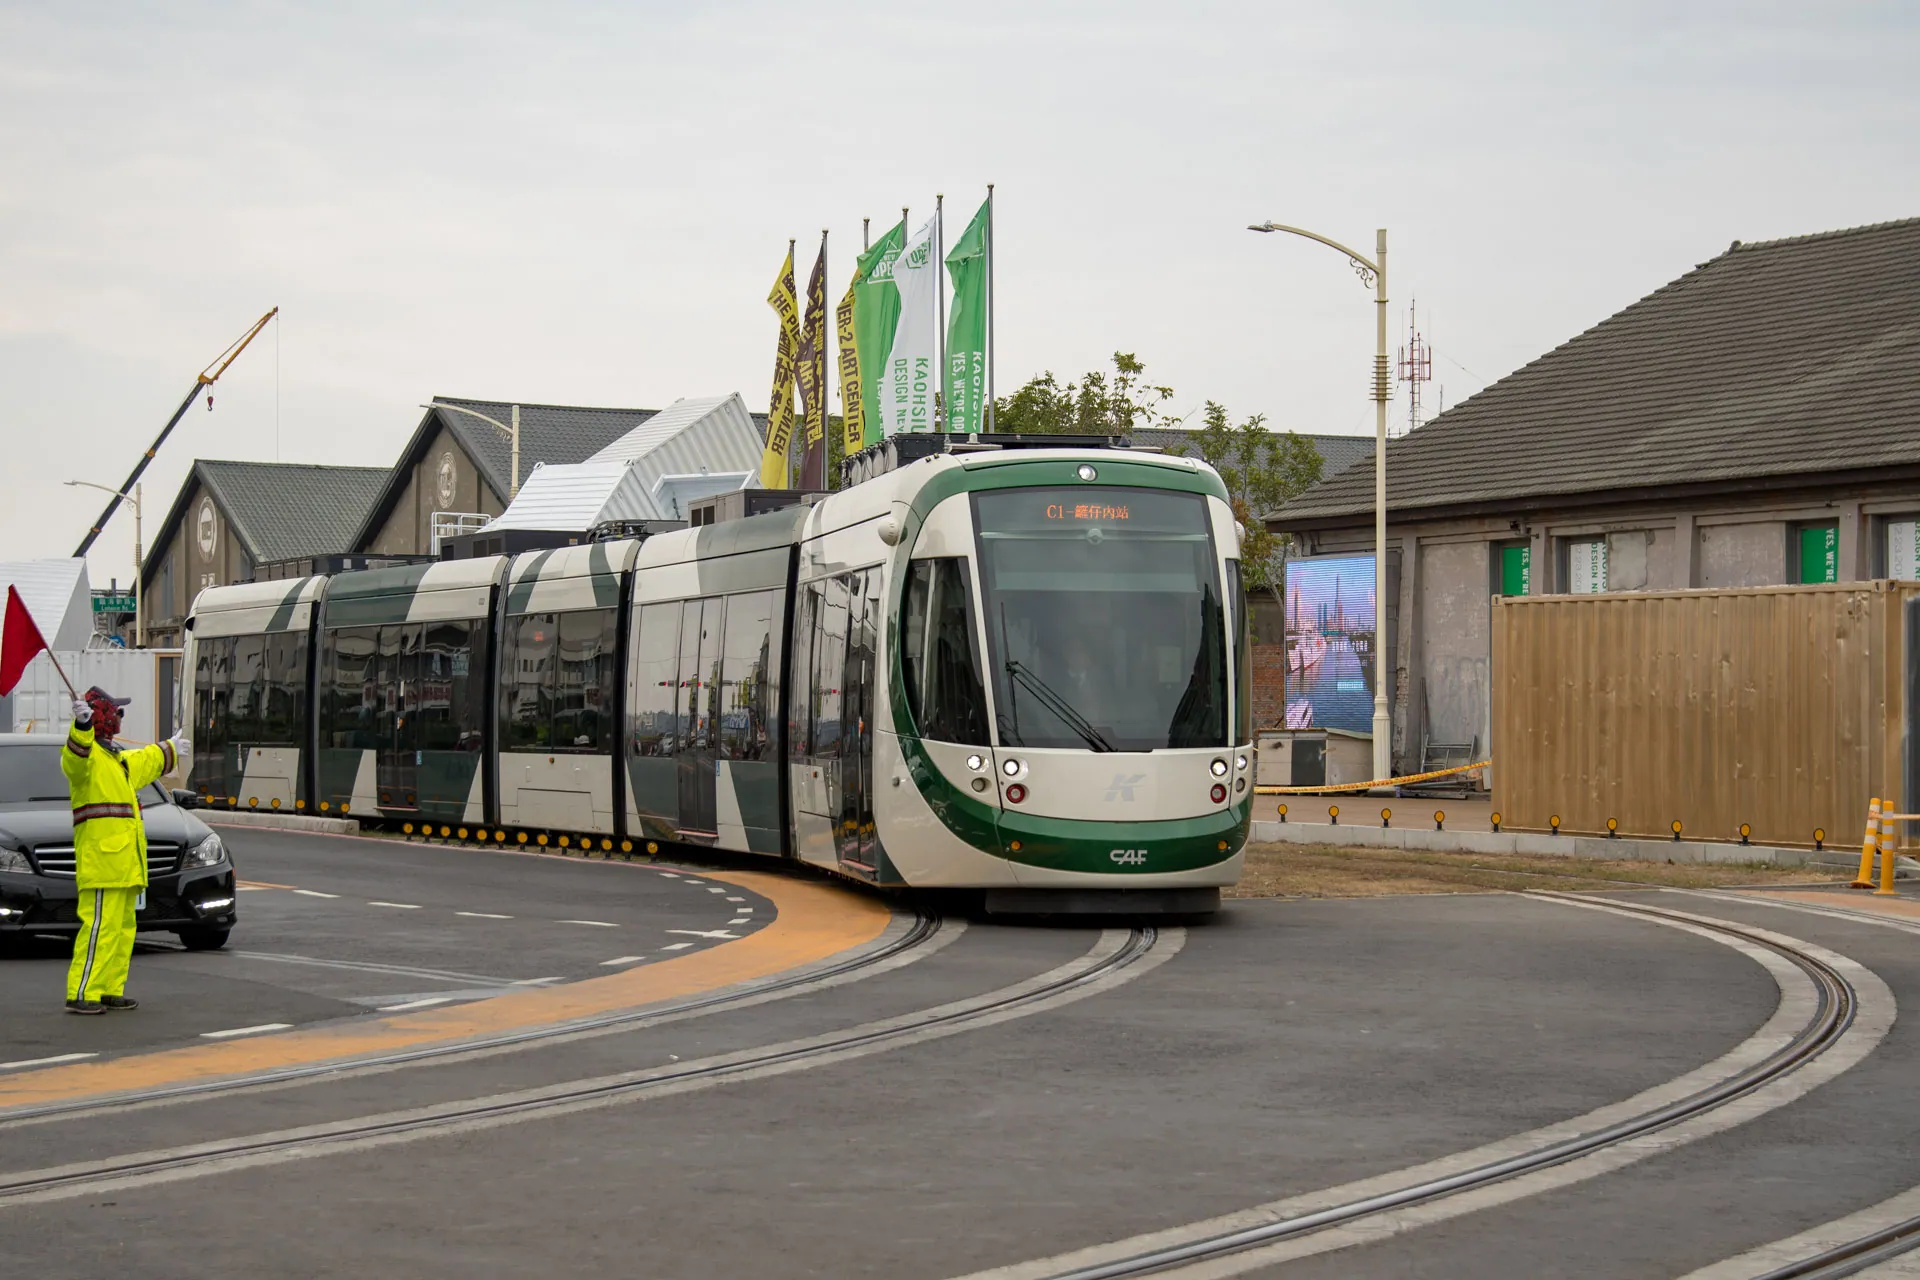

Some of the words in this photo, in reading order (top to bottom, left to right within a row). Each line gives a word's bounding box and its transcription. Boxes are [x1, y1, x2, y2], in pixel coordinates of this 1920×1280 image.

[837, 300, 853, 344] IER-2
[841, 347, 858, 377] ART
[952, 352, 965, 376] YES,
[894, 358, 908, 403] DESIGN
[911, 358, 929, 433] KAOHSIU
[1825, 528, 1834, 549] YES,
[1521, 547, 1529, 566] YES,
[1825, 551, 1834, 581] WE'RE
[1521, 567, 1529, 594] WE'RE
[1109, 849, 1148, 865] CAF
